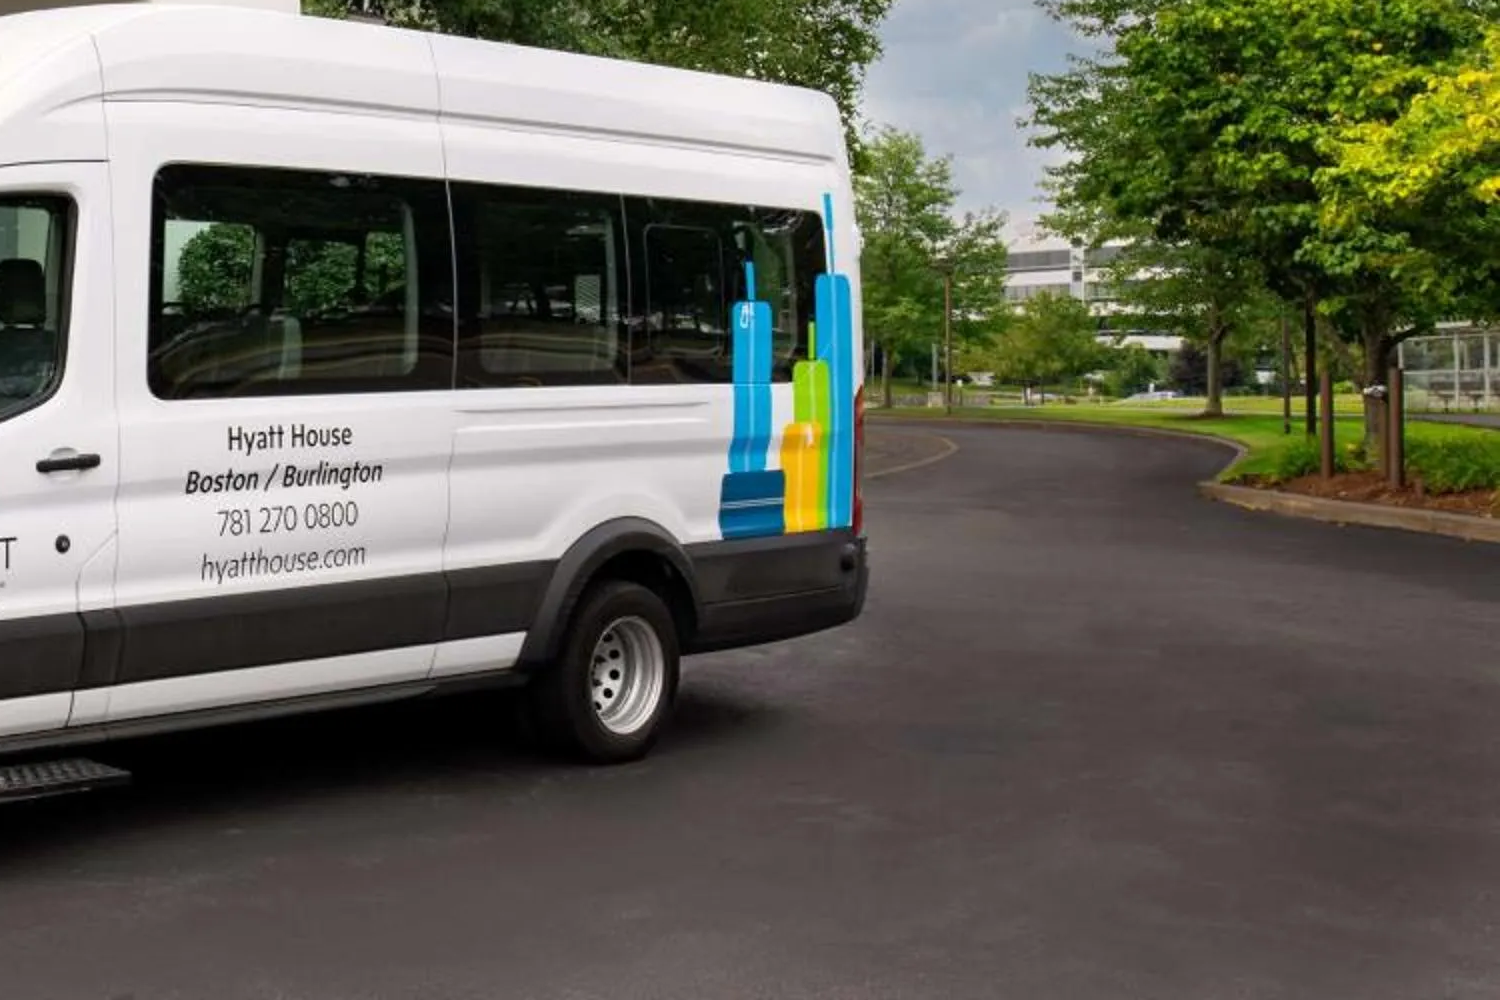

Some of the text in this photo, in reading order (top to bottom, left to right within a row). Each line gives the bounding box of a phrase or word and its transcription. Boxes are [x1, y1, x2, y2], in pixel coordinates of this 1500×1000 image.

[227, 423, 352, 456] Hyatt House
[185, 468, 259, 495] Boston
[282, 460, 383, 490] Burlington
[217, 500, 358, 537] 781 270 0800
[201, 546, 366, 585] hyatthouse.com
